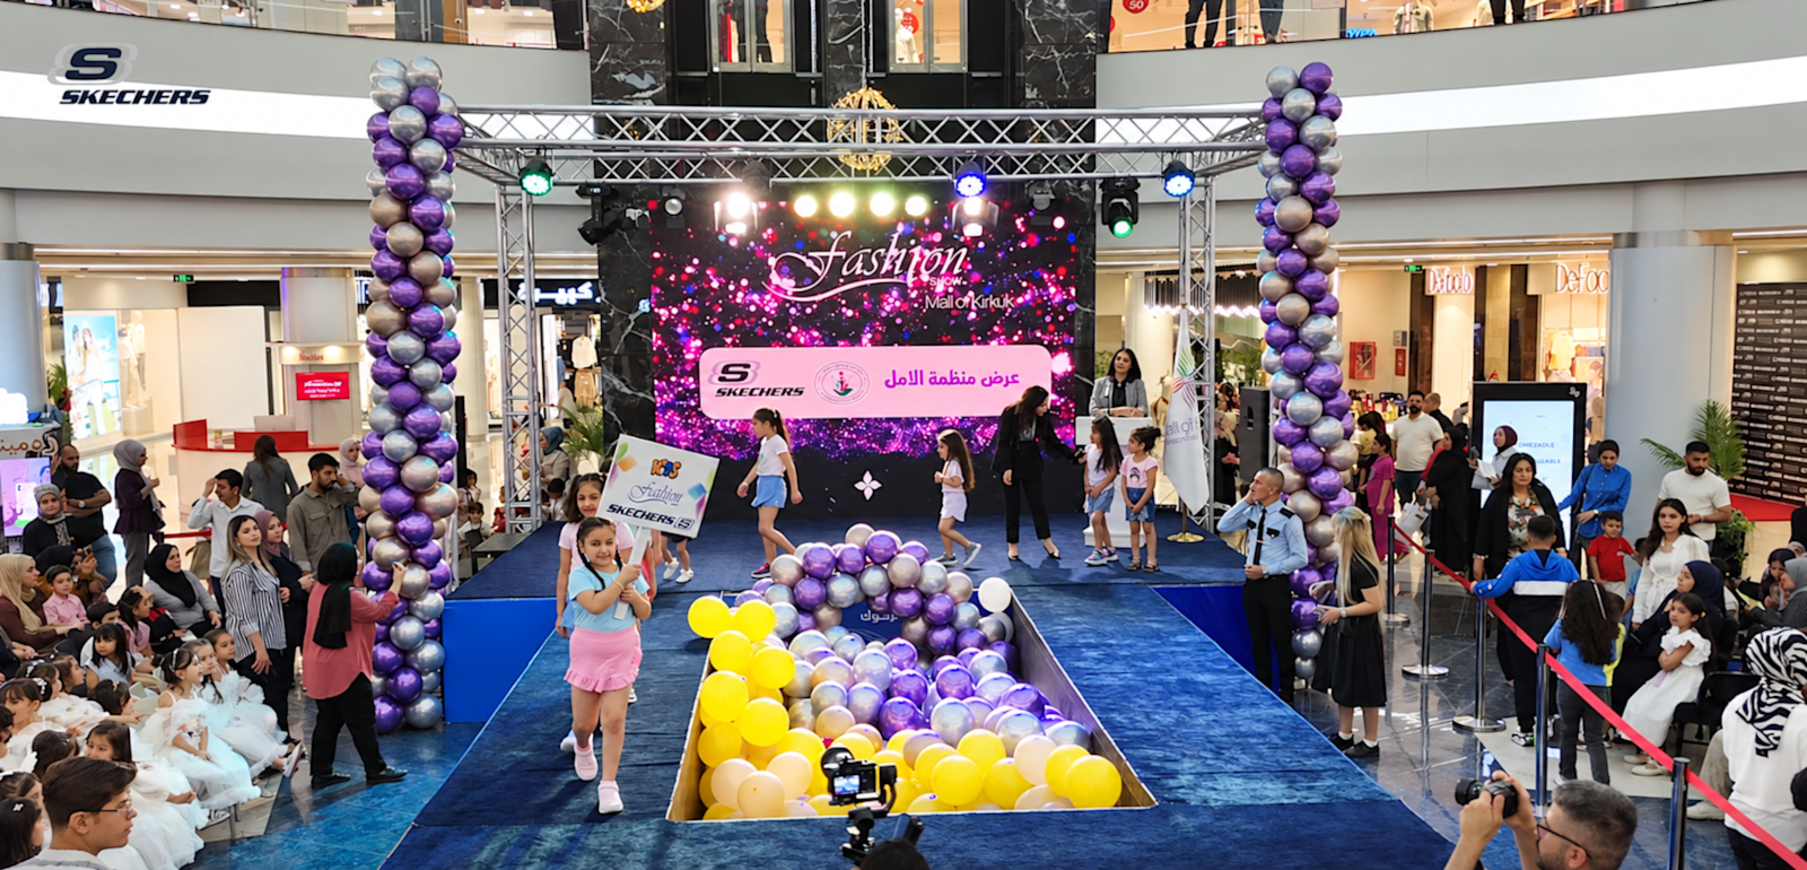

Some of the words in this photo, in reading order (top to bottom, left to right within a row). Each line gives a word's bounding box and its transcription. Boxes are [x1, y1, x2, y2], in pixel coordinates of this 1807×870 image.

[925, 294, 954, 309] Mall
[971, 293, 1015, 310] Kirkuk
[717, 363, 752, 383] S
[884, 369, 924, 389] الامل
[928, 369, 976, 386] منظمة
[981, 370, 1020, 388] عرض
[715, 387, 805, 398] SKECHERS
[606, 503, 676, 525] SKECHERS
